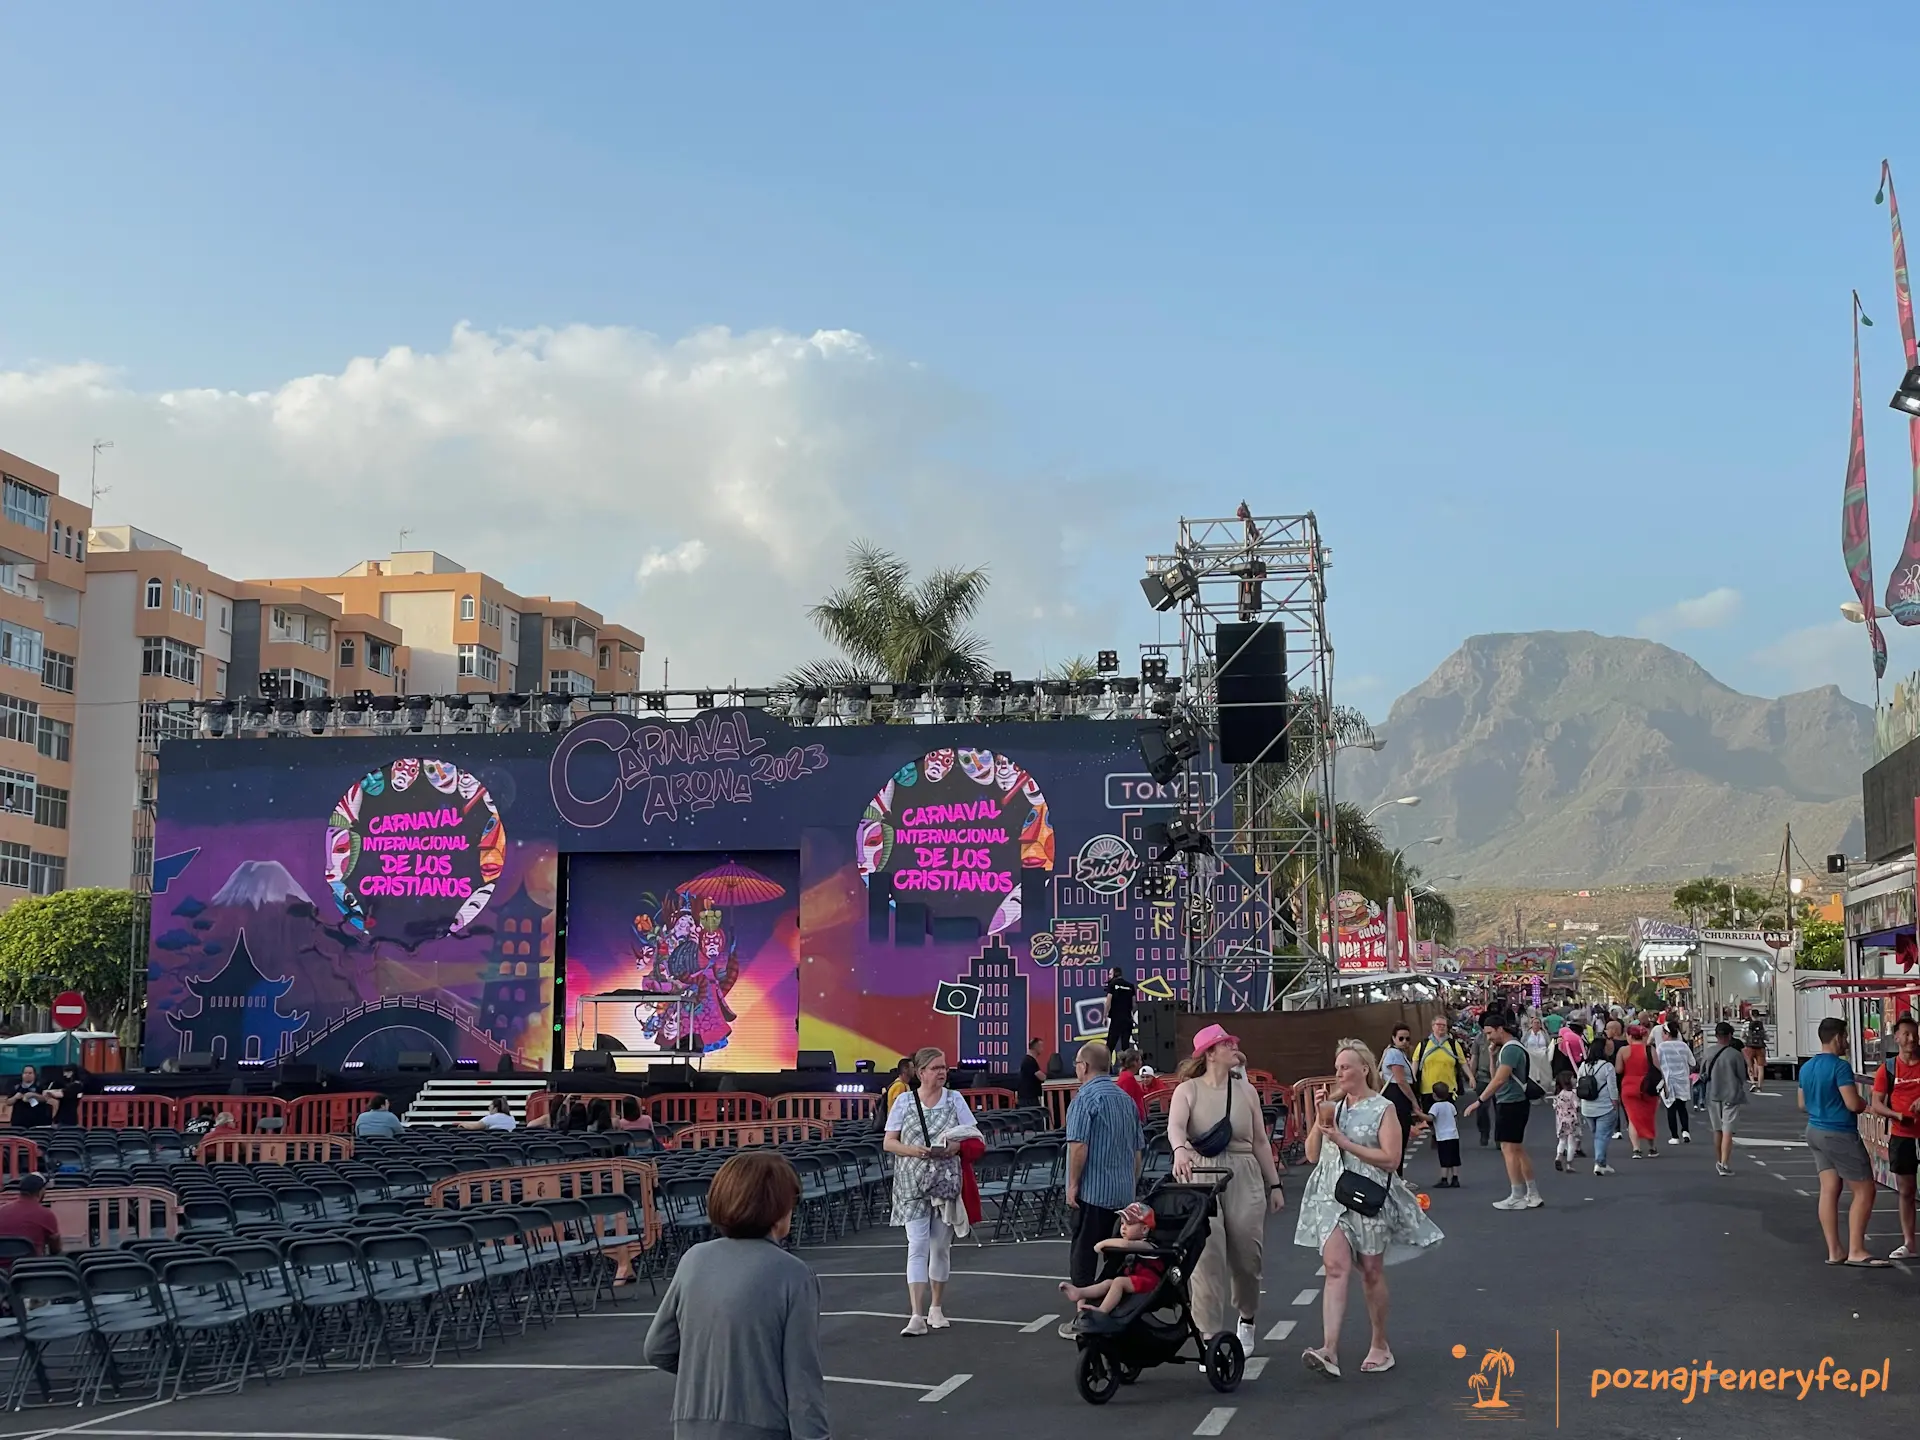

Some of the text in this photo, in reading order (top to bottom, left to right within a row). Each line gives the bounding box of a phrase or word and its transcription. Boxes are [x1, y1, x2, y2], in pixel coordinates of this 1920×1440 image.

[550, 711, 766, 828] CARNAVAL
[643, 744, 828, 825] ARONA 2023
[368, 807, 463, 835] CARNAVAL
[902, 799, 1002, 826] CARNAVAL
[362, 835, 470, 851] INTERNACIONAL
[896, 828, 1010, 844] INTERNACIONAL
[379, 854, 452, 875] DE LOS
[914, 847, 992, 869] DE LOS
[1075, 849, 1141, 882] Sushi
[359, 875, 472, 897] CRISTIANOS
[893, 869, 1013, 892] CRISTIANOS
[1054, 921, 1099, 945] 寿司
[1704, 931, 1762, 941] CHURRERIA
[1061, 944, 1098, 955] SUSHI
[1322, 935, 1360, 959] RMÓN
